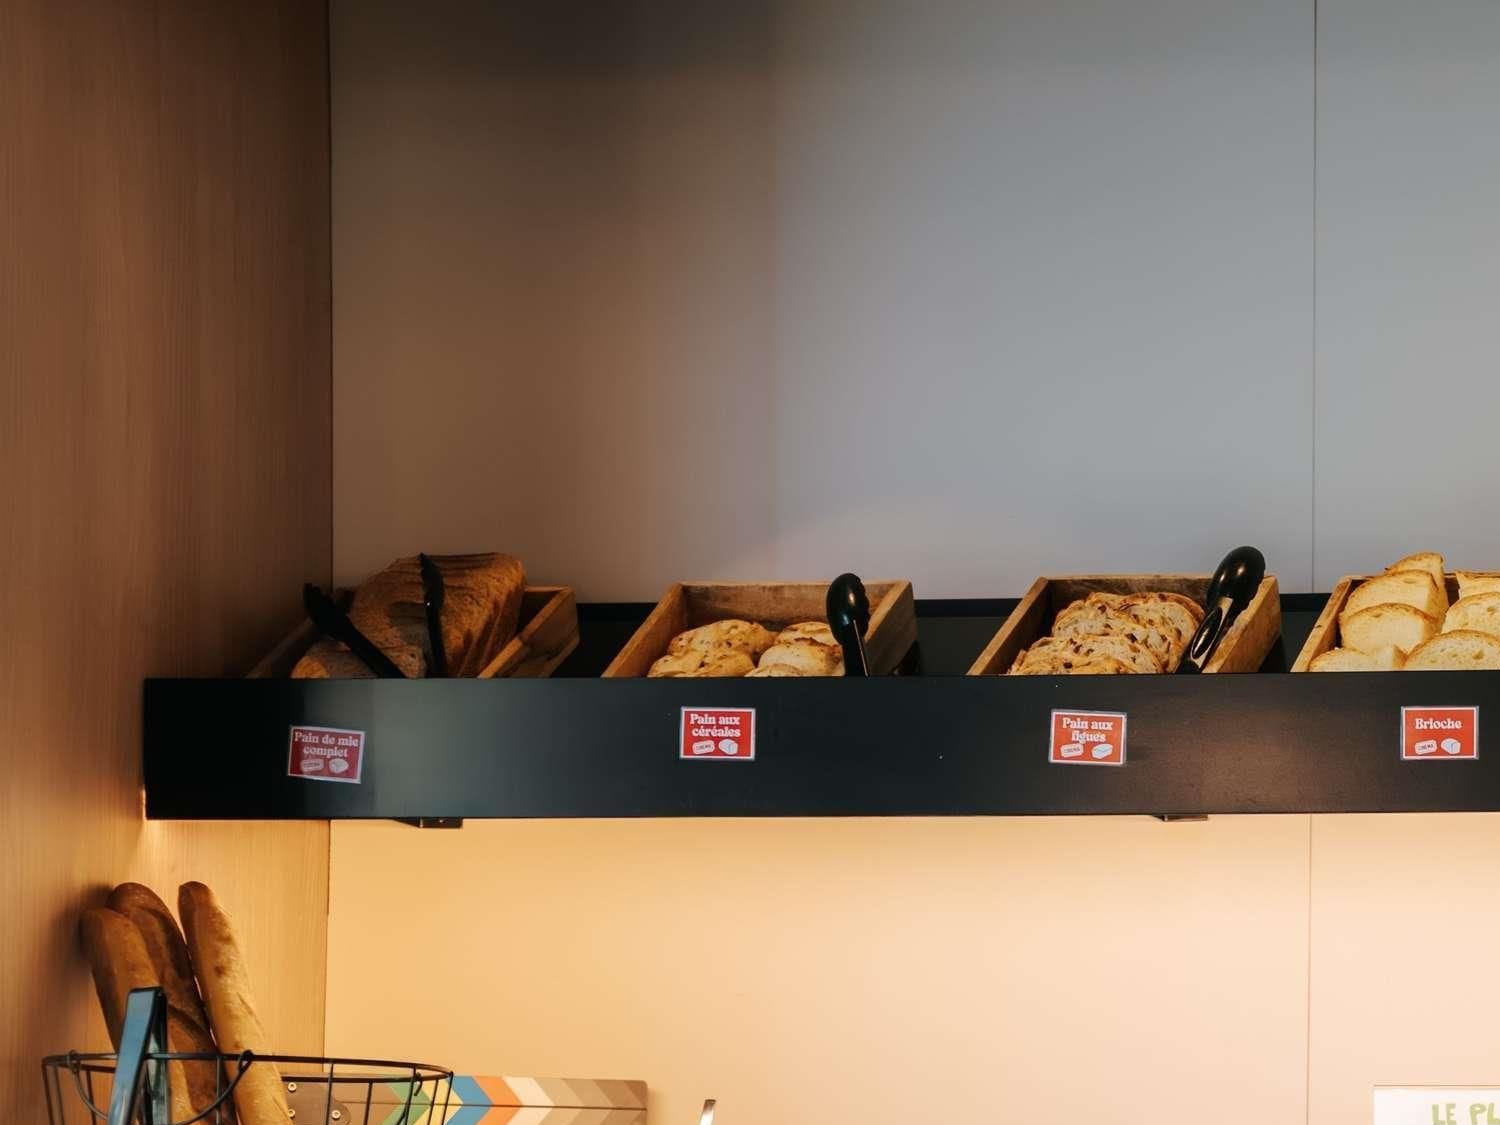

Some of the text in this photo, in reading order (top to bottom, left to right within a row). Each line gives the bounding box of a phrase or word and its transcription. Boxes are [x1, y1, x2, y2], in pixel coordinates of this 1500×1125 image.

[689, 713, 740, 725] Pain aux
[1062, 717, 1113, 731] Pain aux
[1415, 717, 1462, 730] Brioche
[691, 725, 741, 737] céréales
[1071, 730, 1106, 745] figues
[294, 731, 359, 747] Pain de mie
[303, 745, 348, 759] complet
[1431, 1103, 1457, 1125] LE
